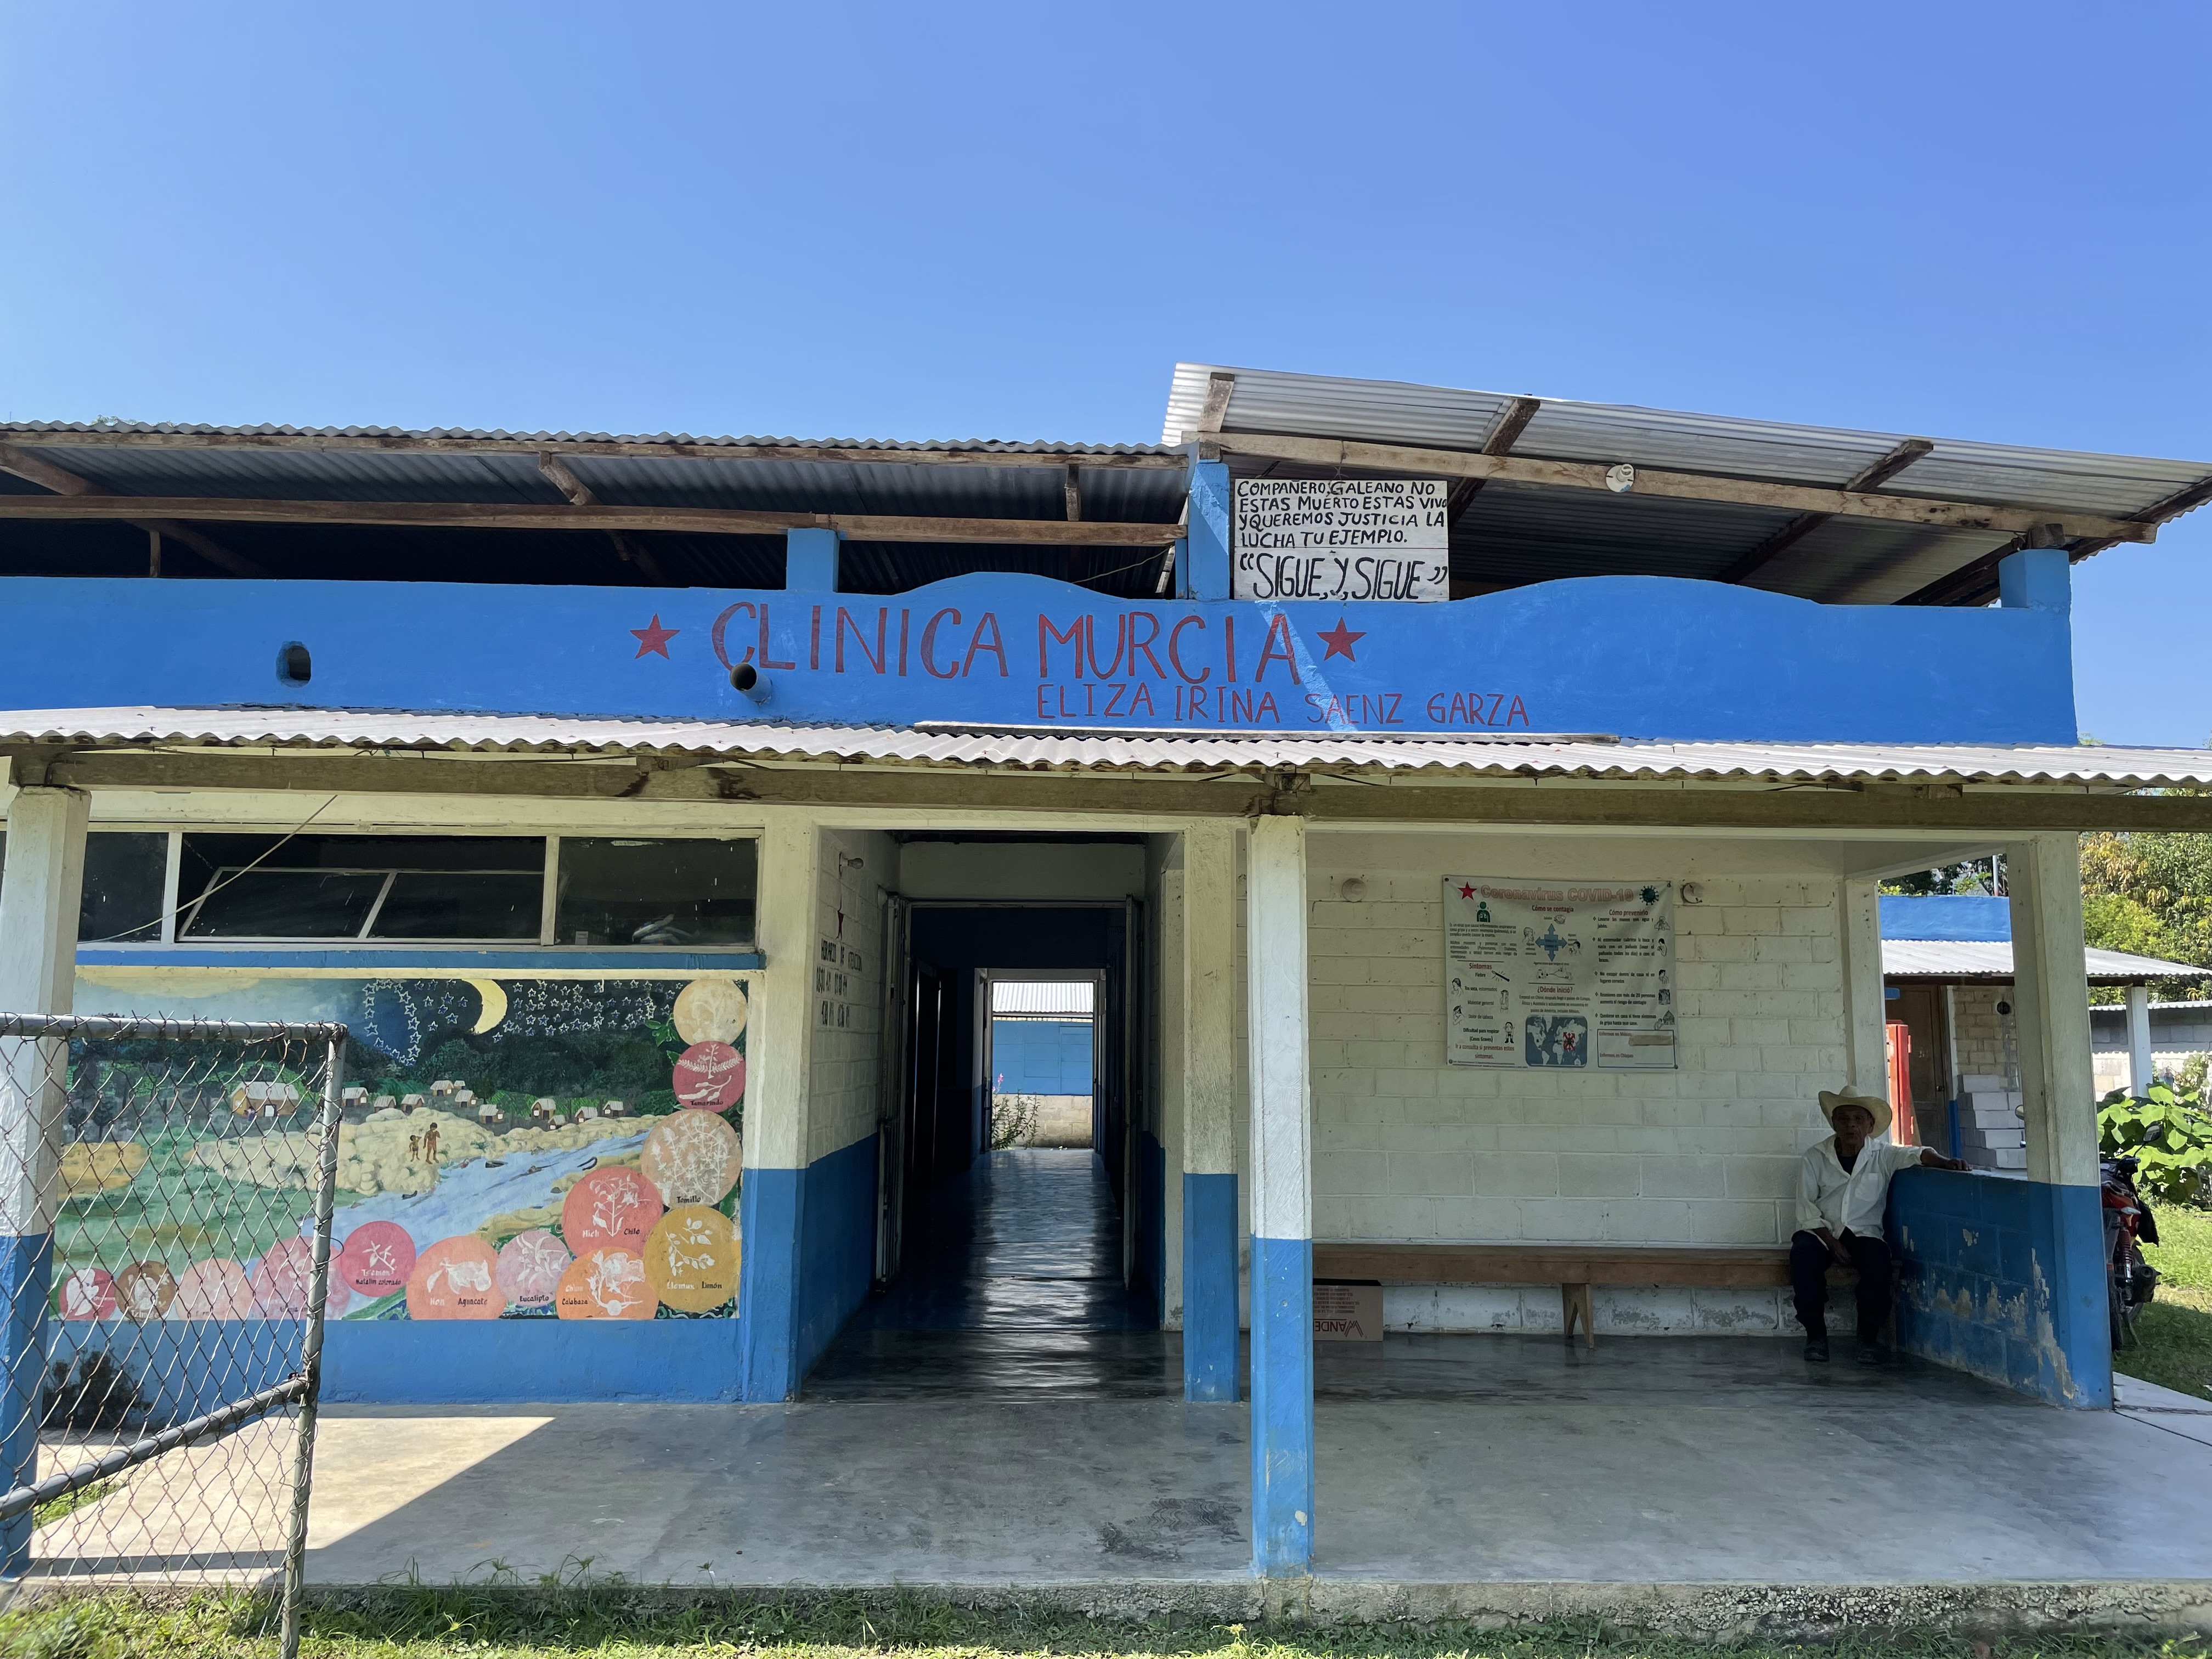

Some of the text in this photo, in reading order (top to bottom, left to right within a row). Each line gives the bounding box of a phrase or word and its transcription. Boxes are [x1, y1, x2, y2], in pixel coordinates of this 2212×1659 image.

[1330, 481, 1403, 495] GALEANO
[1411, 482, 1435, 495] NO
[1240, 498, 1290, 512] ESTAS
[1298, 496, 1359, 511] MUERTO
[1363, 495, 1414, 510] ESTAS
[1338, 512, 1418, 527] JUSTICIA
[1426, 511, 1444, 527] LA
[1242, 529, 1408, 548] LUCHA TU EJEMPLO.
[712, 602, 1301, 685] CLINICA MURCIA
[1038, 682, 1528, 727] ELIZA IRINA SAENZ GARZA
[1567, 887, 1634, 902] COVID-19
[519, 1294, 549, 1303] Eucalipto
[1313, 1320, 1364, 1338] WANDE
